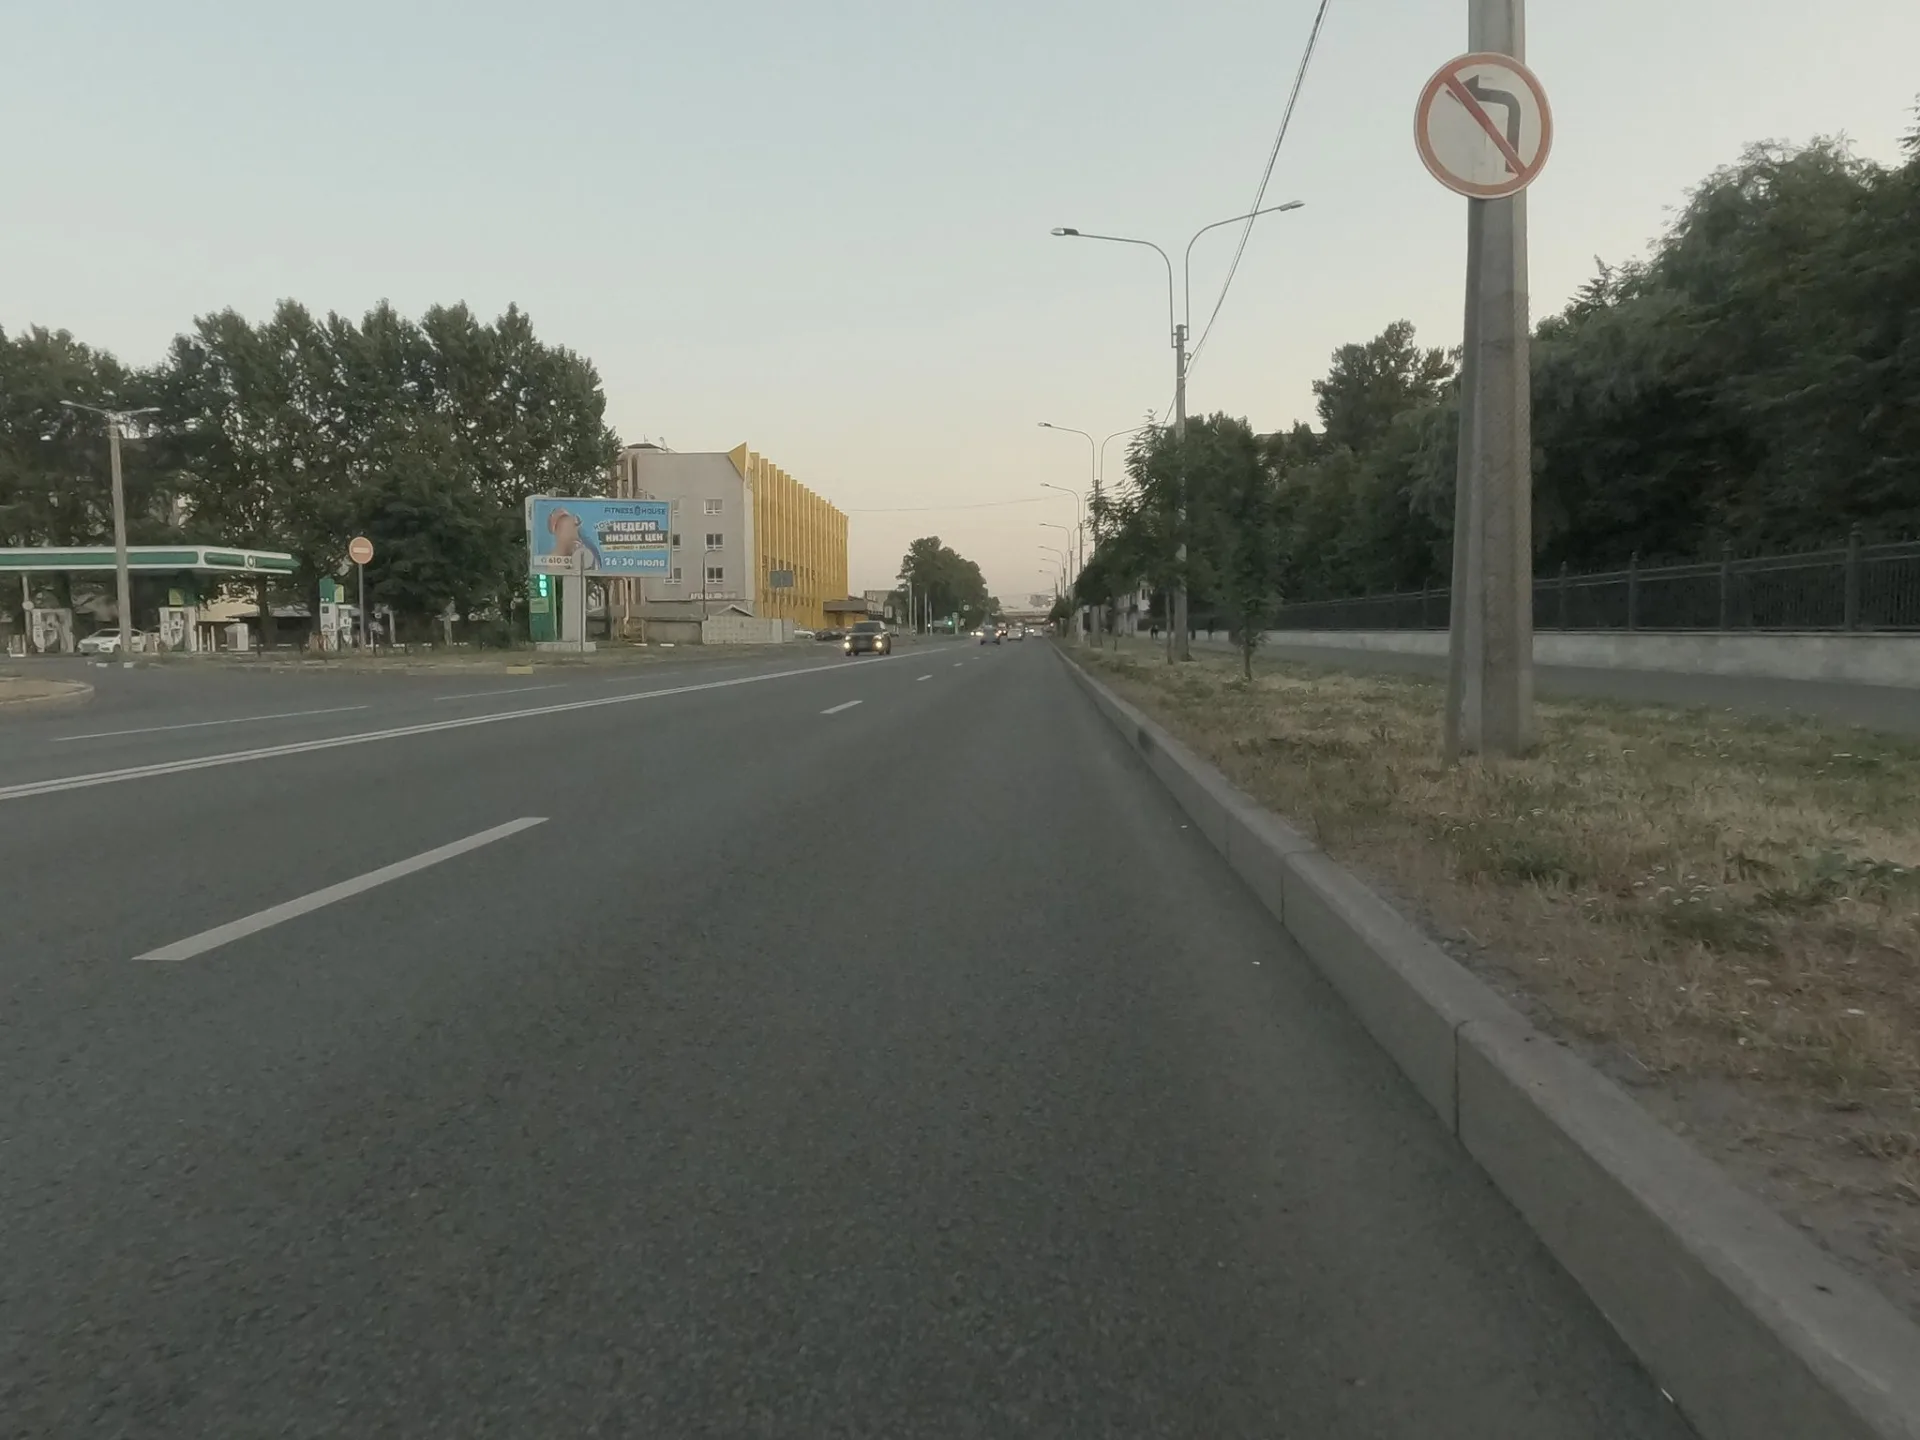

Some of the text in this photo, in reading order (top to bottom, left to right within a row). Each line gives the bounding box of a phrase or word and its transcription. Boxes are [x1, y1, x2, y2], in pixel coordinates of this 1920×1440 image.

[613, 521, 656, 532] НЕДЕЛЯ
[605, 533, 664, 542] НИЗКИХ ЦЕН
